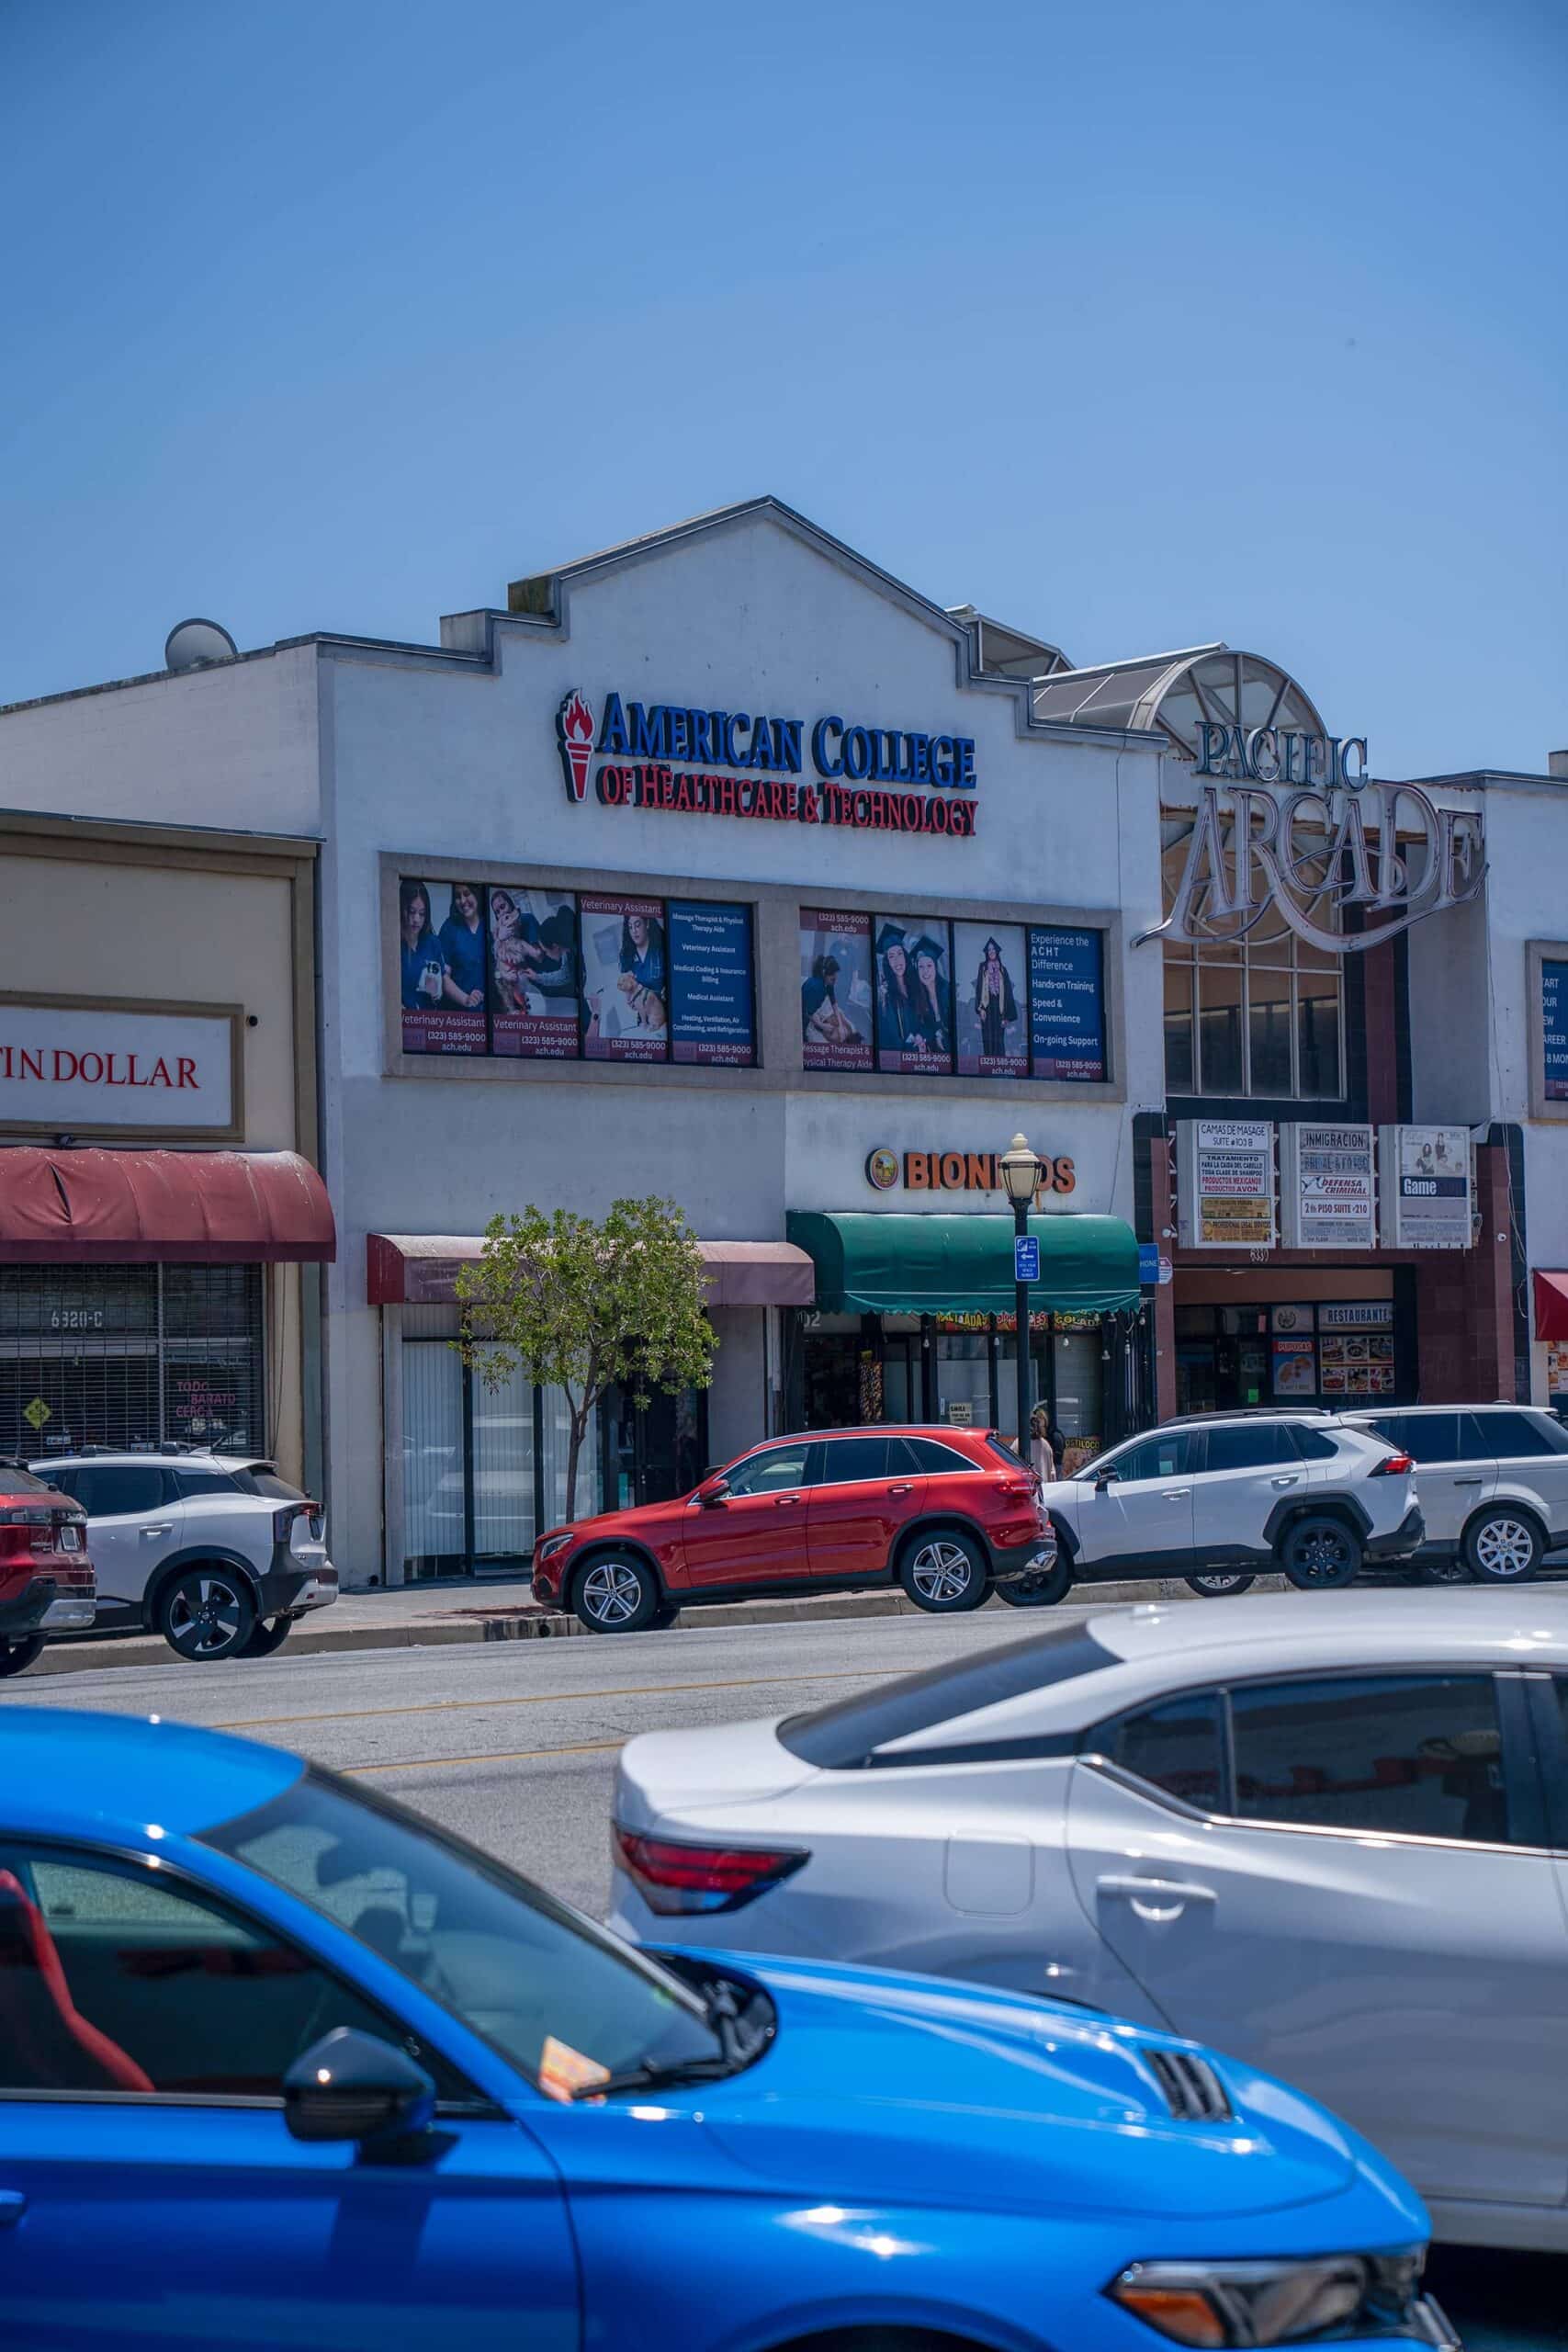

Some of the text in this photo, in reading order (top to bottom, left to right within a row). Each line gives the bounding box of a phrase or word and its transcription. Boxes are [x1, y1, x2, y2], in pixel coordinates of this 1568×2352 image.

[595, 692, 976, 789] AMERICAN COLLEGE
[1194, 721, 1369, 792] PACIFIC
[596, 764, 978, 837] OF HEALTHCARE & TECHNOLOGY
[1131, 779, 1489, 953] ARCADE
[581, 899, 662, 915] Veterinary Assistant
[1031, 933, 1089, 947] Experience the
[1032, 959, 1074, 971] Difference
[1032, 979, 1094, 994] Hands-on Training
[1542, 978, 1559, 989] ART
[1032, 998, 1055, 1010] Speed
[446, 1016, 486, 1028] Assistant
[1033, 1013, 1081, 1024] Convenience
[493, 1019, 578, 1033] Veterinary Assistant
[427, 1030, 486, 1043] (323) 585-9000
[1033, 1035, 1100, 1047] On-going Support
[442, 1043, 472, 1052] ach.edu
[0, 1046, 46, 1081] IN
[1201, 1124, 1225, 1135] CAMAS
[1226, 1125, 1235, 1135] DE
[1213, 1136, 1229, 1147] SUITE
[1305, 1131, 1365, 1148] INMIGRACION
[904, 1151, 1075, 1193] BIONIOS
[1323, 1179, 1363, 1187] DEFENSA
[1404, 1178, 1438, 1196] Game
[1325, 1186, 1368, 1194] CRIMINAL
[1317, 1204, 1332, 1214] PISO
[1327, 1308, 1391, 1324] RESTAURANTE
